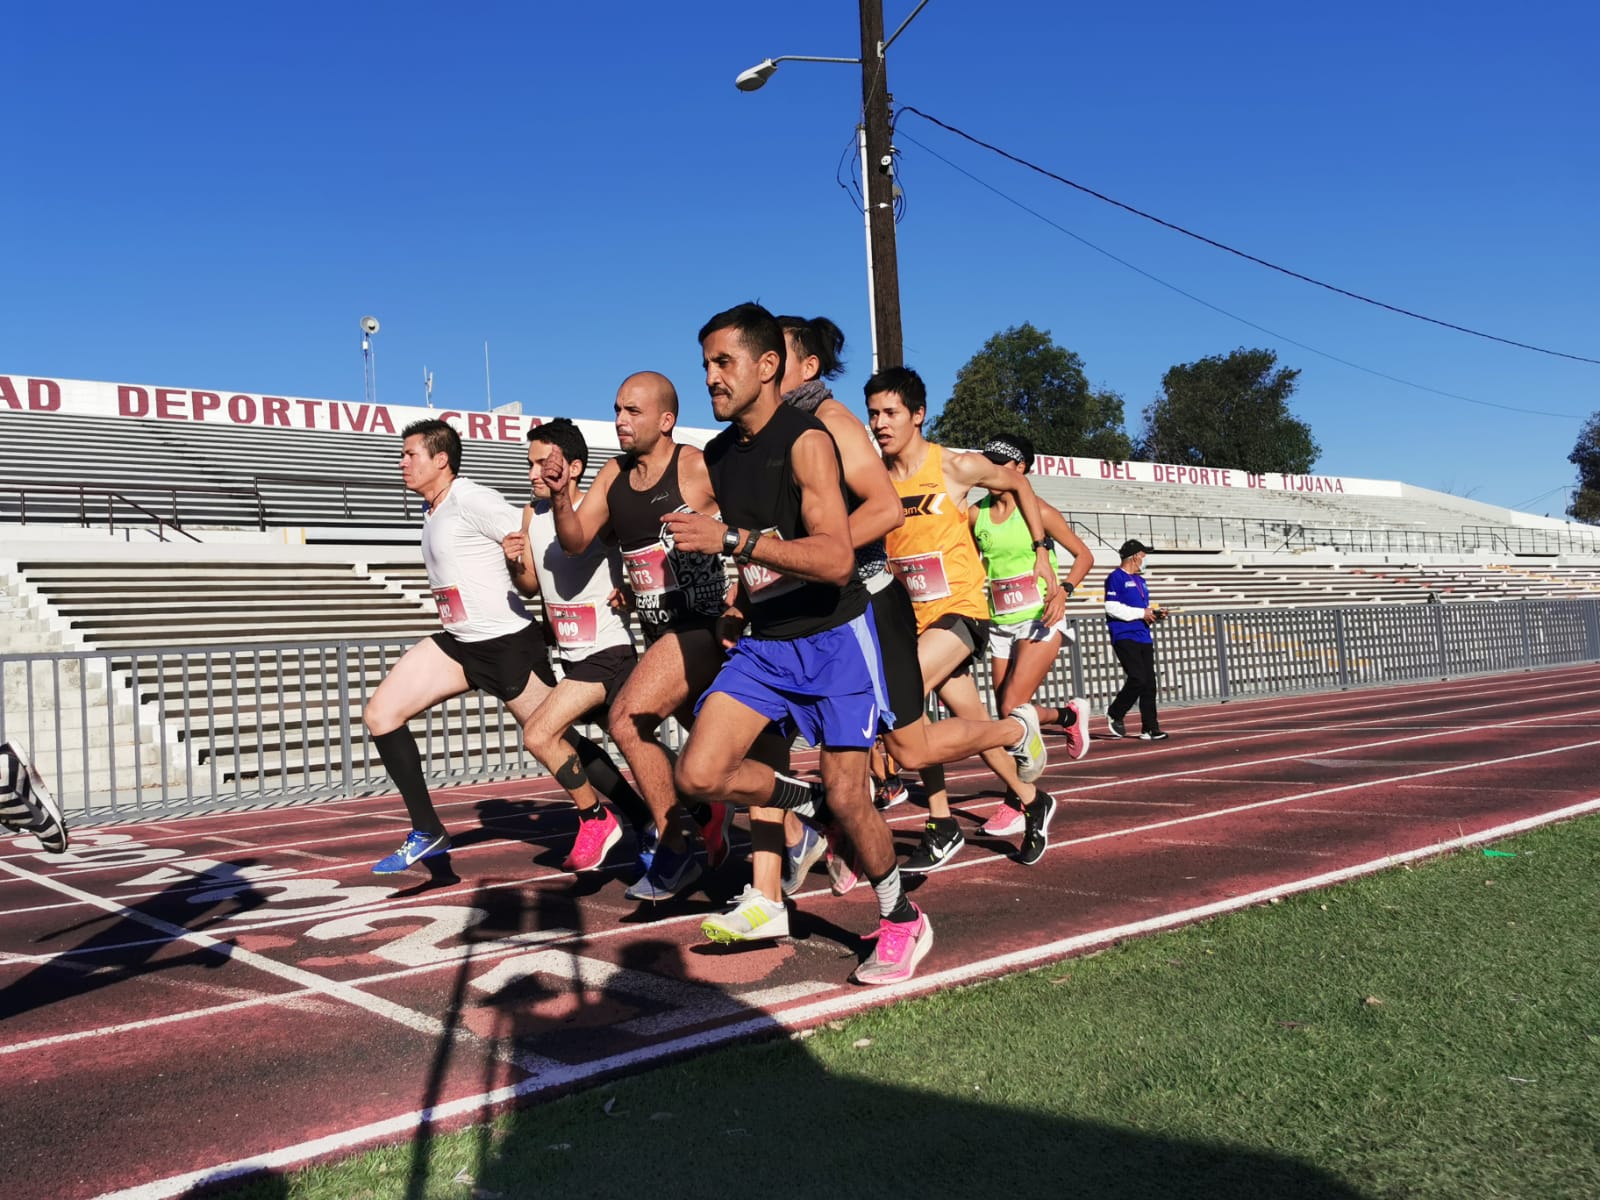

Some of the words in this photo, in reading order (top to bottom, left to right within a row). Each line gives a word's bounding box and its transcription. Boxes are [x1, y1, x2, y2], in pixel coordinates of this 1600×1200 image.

[0, 376, 61, 411] AD
[117, 385, 396, 434] DEPORTIVA
[1029, 456, 1081, 476] IPAL
[1100, 460, 1136, 480] DEL
[1153, 465, 1231, 487] DEPORTE
[1247, 472, 1267, 488] DE
[1281, 474, 1344, 493] TIJUANA
[743, 564, 771, 586] 092
[906, 574, 927, 591] 063
[1003, 590, 1023, 605] 070
[557, 621, 579, 637] 009
[32, 843, 186, 869] 5
[116, 858, 299, 887] 4
[186, 878, 402, 921] 3
[302, 905, 582, 966] 2
[467, 948, 842, 1037] 1
